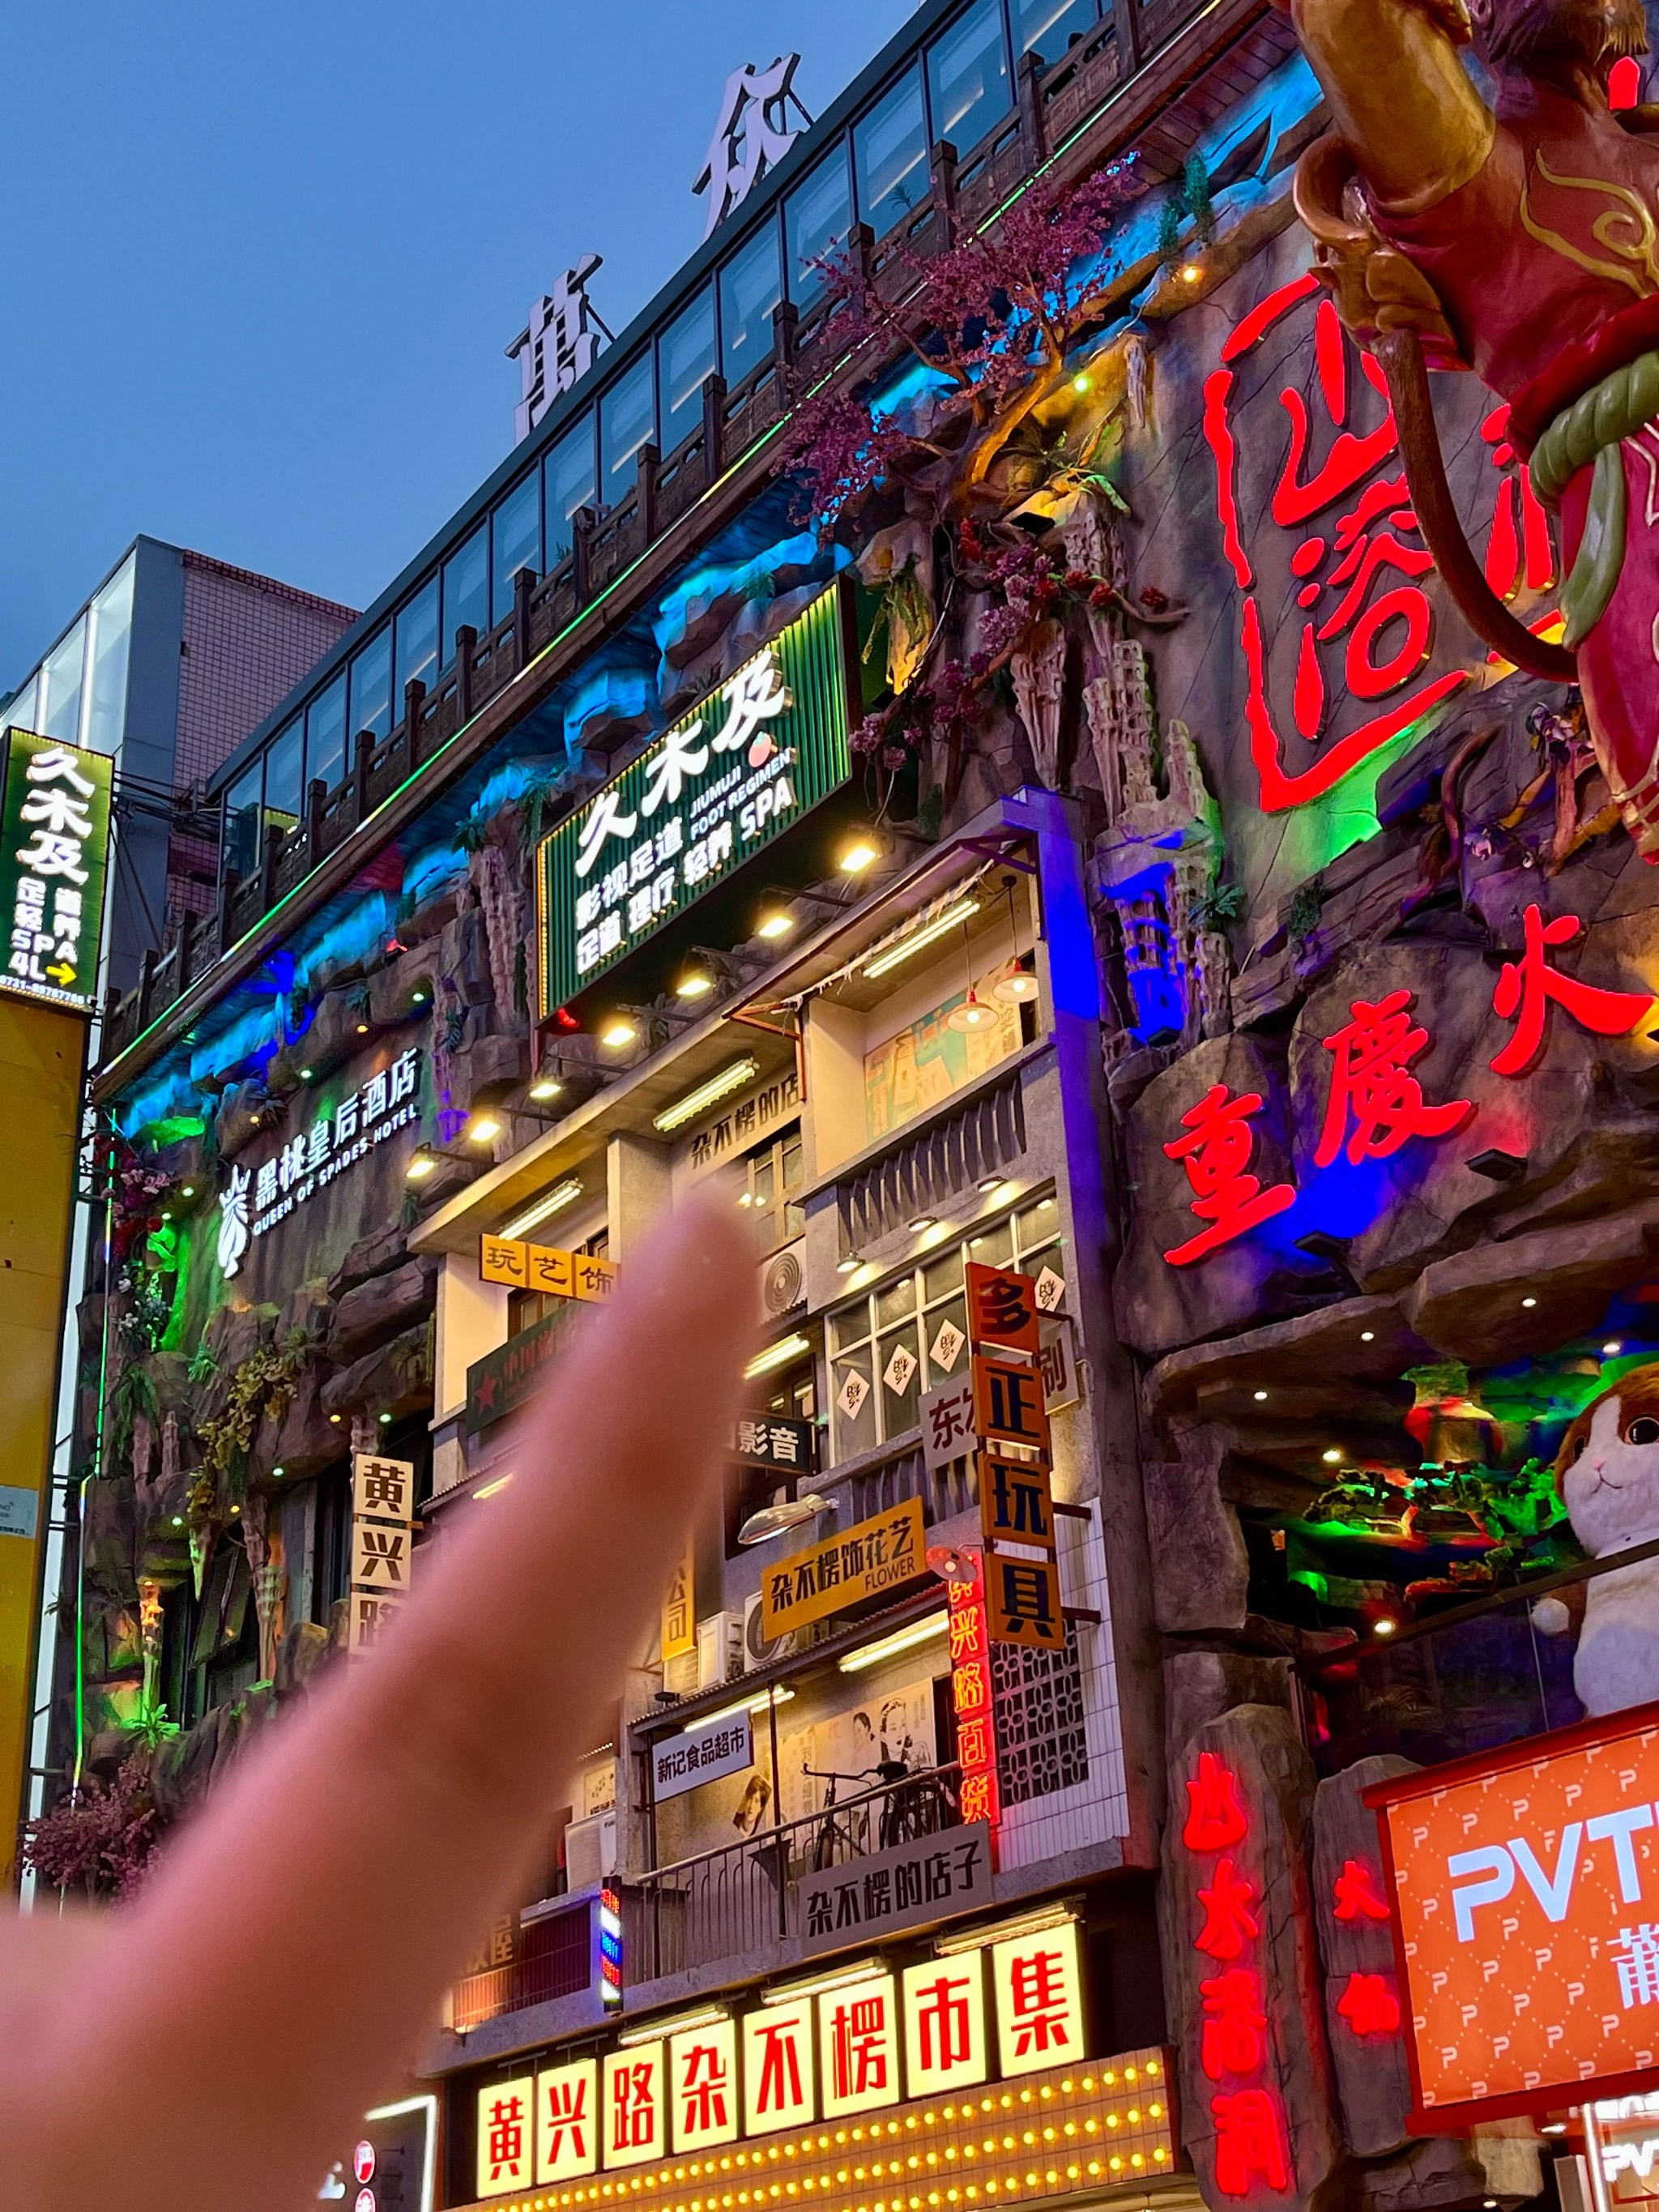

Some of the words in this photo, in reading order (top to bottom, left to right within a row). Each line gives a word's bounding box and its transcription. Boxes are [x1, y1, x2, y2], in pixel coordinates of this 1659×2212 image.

[575, 651, 786, 878] 久木及
[690, 801, 725, 840] FOOT
[728, 748, 791, 811] REGIMEN
[691, 766, 741, 819] JIUMUJI
[740, 777, 793, 841] SPA
[15, 747, 95, 886] 久木及
[11, 929, 78, 964] SPA
[253, 1197, 292, 1236] QUEEN
[296, 1179, 314, 1202] OF
[319, 1137, 368, 1187] SPADES
[373, 1103, 416, 1144] HOTEL
[254, 1047, 418, 1212] 黑桃皇后酒店
[980, 1277, 1056, 1638] 多正玩具
[772, 1516, 914, 1613] 杂不楞饰花艺
[865, 1557, 915, 1591] FLOWER
[658, 1727, 744, 1783] 新记食品超市
[808, 1839, 983, 1937] 杂不楞的店子
[1448, 1801, 1659, 1942] PVT
[488, 1949, 1069, 2180] 黄兴路杂不楞市集
[1601, 2139, 1659, 2182] PV
